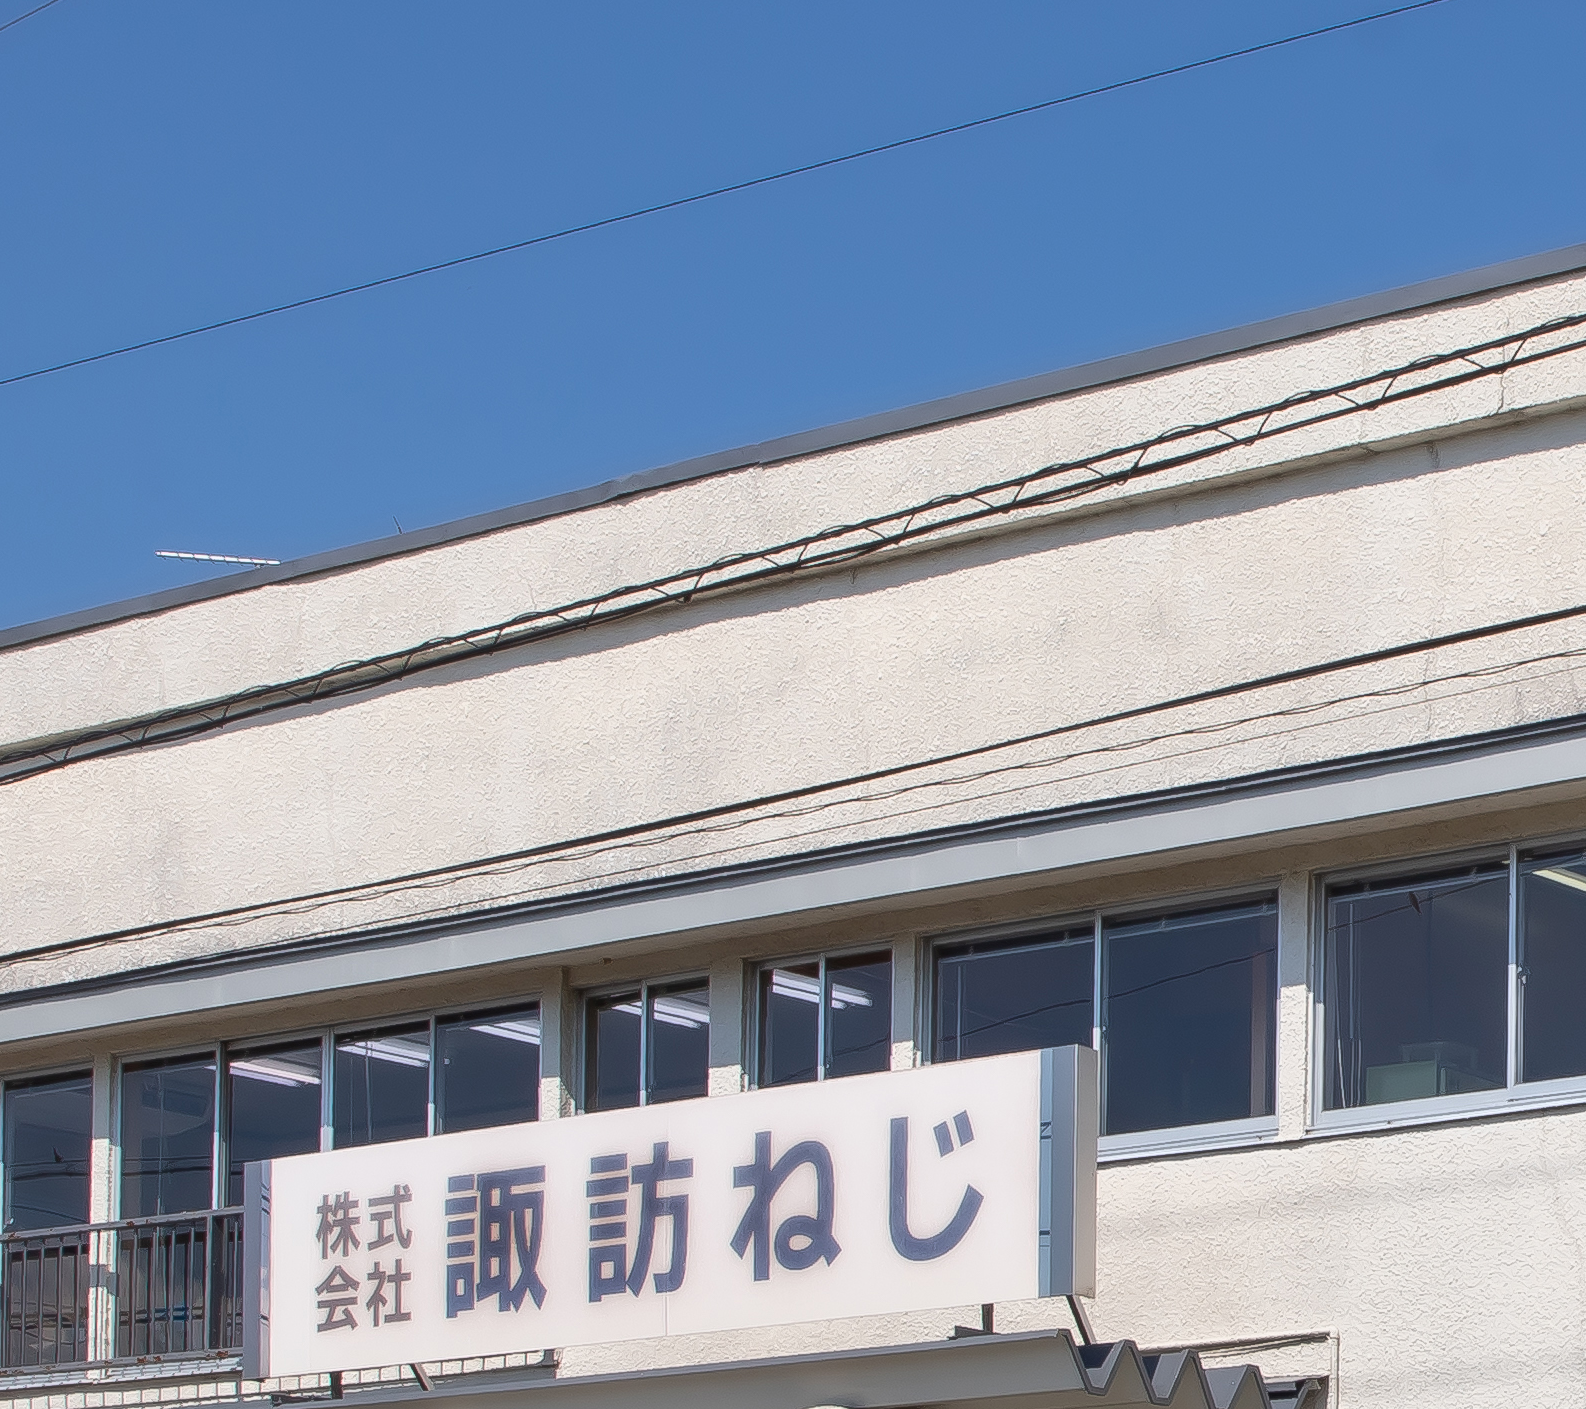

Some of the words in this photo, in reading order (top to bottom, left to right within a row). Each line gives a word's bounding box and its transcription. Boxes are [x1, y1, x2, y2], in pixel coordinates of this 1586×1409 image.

[315, 1183, 414, 1260] 株式
[444, 1109, 985, 1320] 諏訪ねじ
[315, 1257, 413, 1333] 会社
